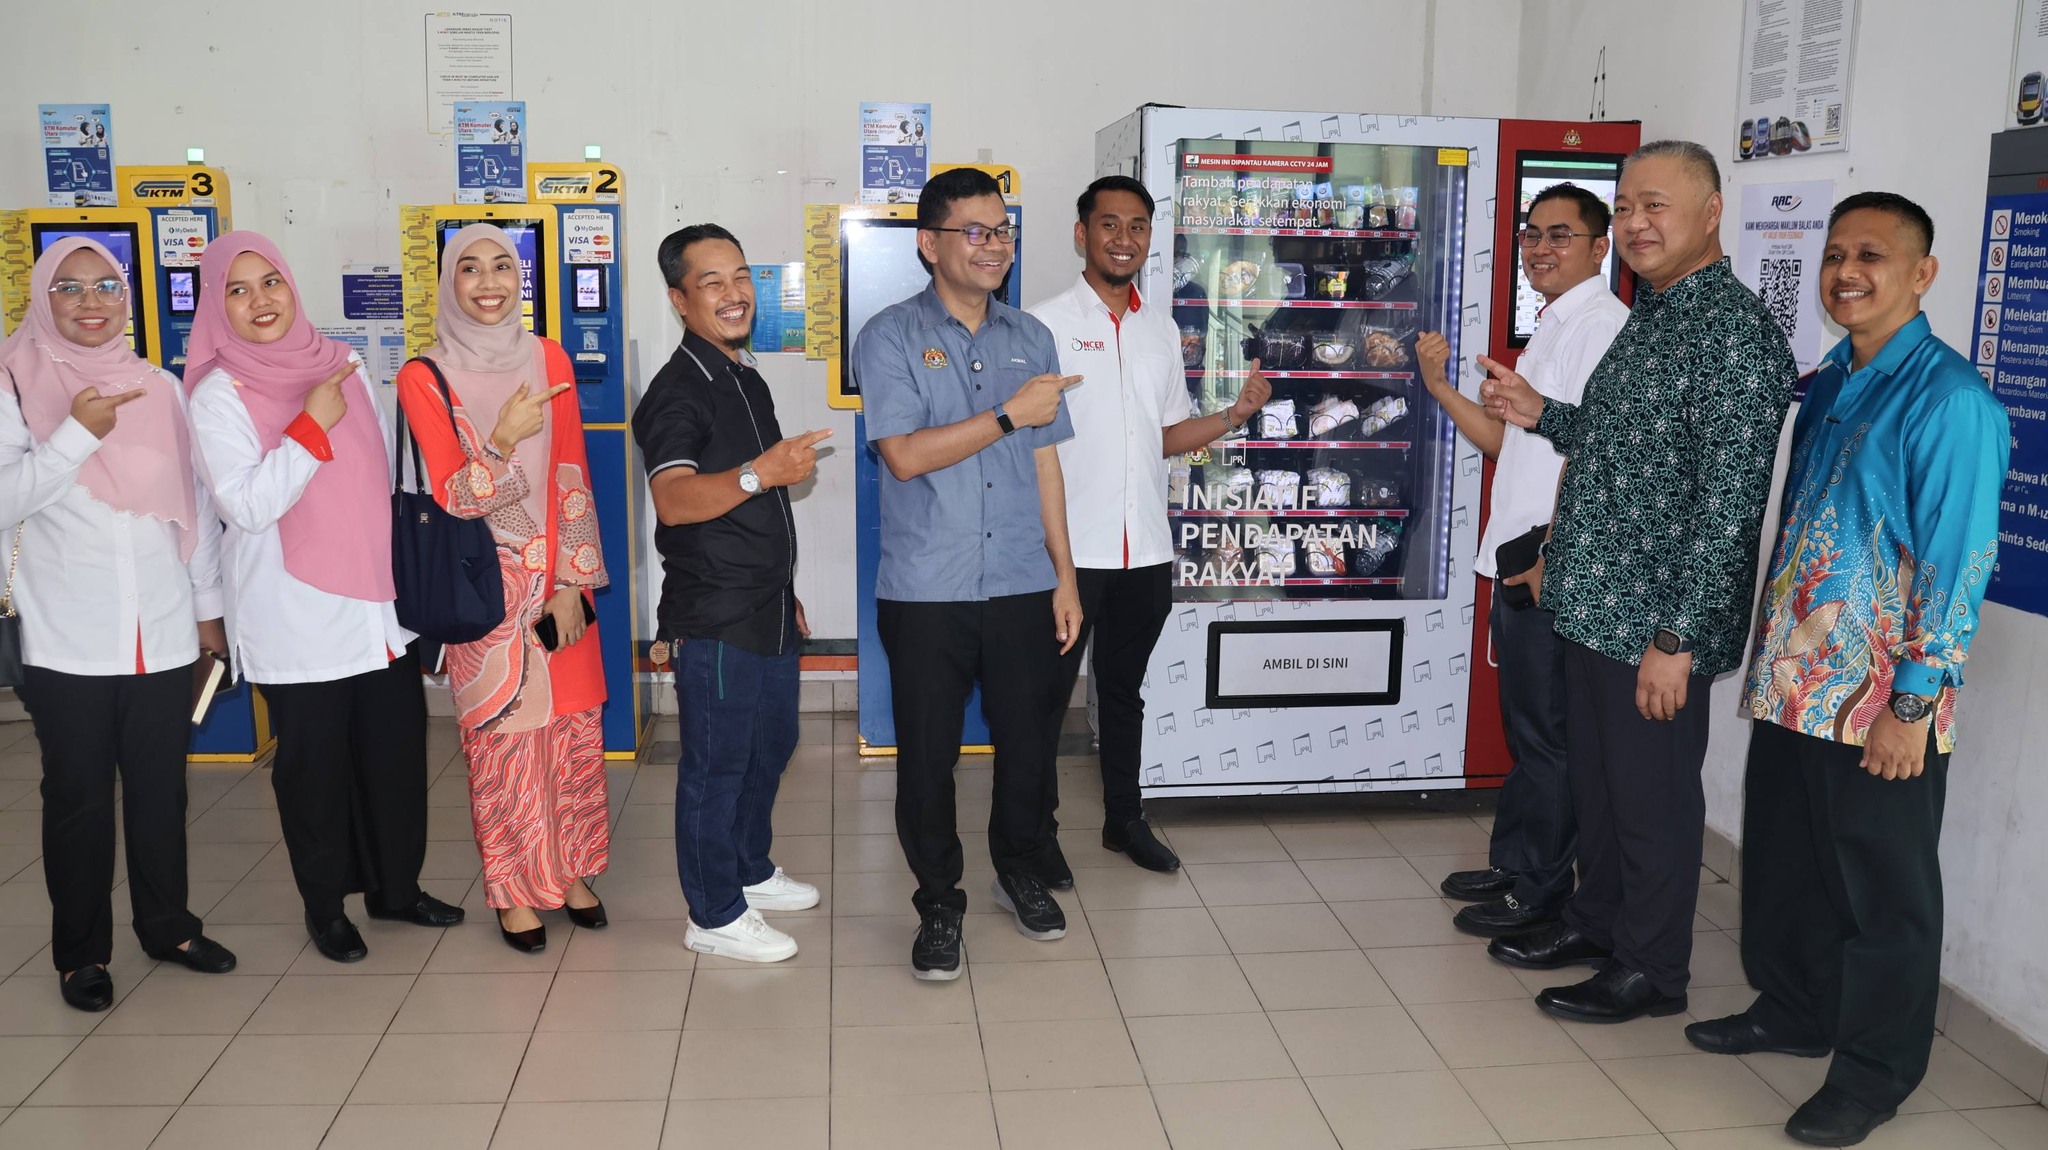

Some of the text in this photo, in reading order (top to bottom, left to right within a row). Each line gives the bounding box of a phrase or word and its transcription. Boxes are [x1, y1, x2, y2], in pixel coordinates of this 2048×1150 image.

[191, 172, 214, 196] 3
[595, 170, 618, 194] 2
[996, 170, 1010, 193] 1
[1182, 176, 1313, 192] Tambah pendapatan
[553, 186, 588, 194] KTM
[1182, 196, 1226, 209] rakyat.
[1292, 199, 1346, 210] ekonomi
[1771, 195, 1792, 206] RAC
[1182, 214, 1320, 229] masyarakat setempat.
[1745, 220, 1824, 230] KAMI MENGHARGAI MAKLUM BALAS ANDA
[2014, 228, 2040, 237] Smoking
[2011, 244, 2046, 257] Makan
[2011, 260, 2029, 270] Eating
[2007, 292, 2031, 302] Littering
[2004, 323, 2043, 334] Chewing Gum
[2000, 355, 2048, 367] Posters and Bills
[1998, 370, 2046, 390] Barangan
[1997, 387, 2027, 397] Hazardous
[2005, 405, 2046, 421] embawa
[1182, 485, 1318, 510] INISIATIF
[1182, 524, 1377, 550] PENDAPATAN
[1180, 562, 1294, 587] RAKYAT
[1262, 657, 1349, 670] AMBIL DI SINI
